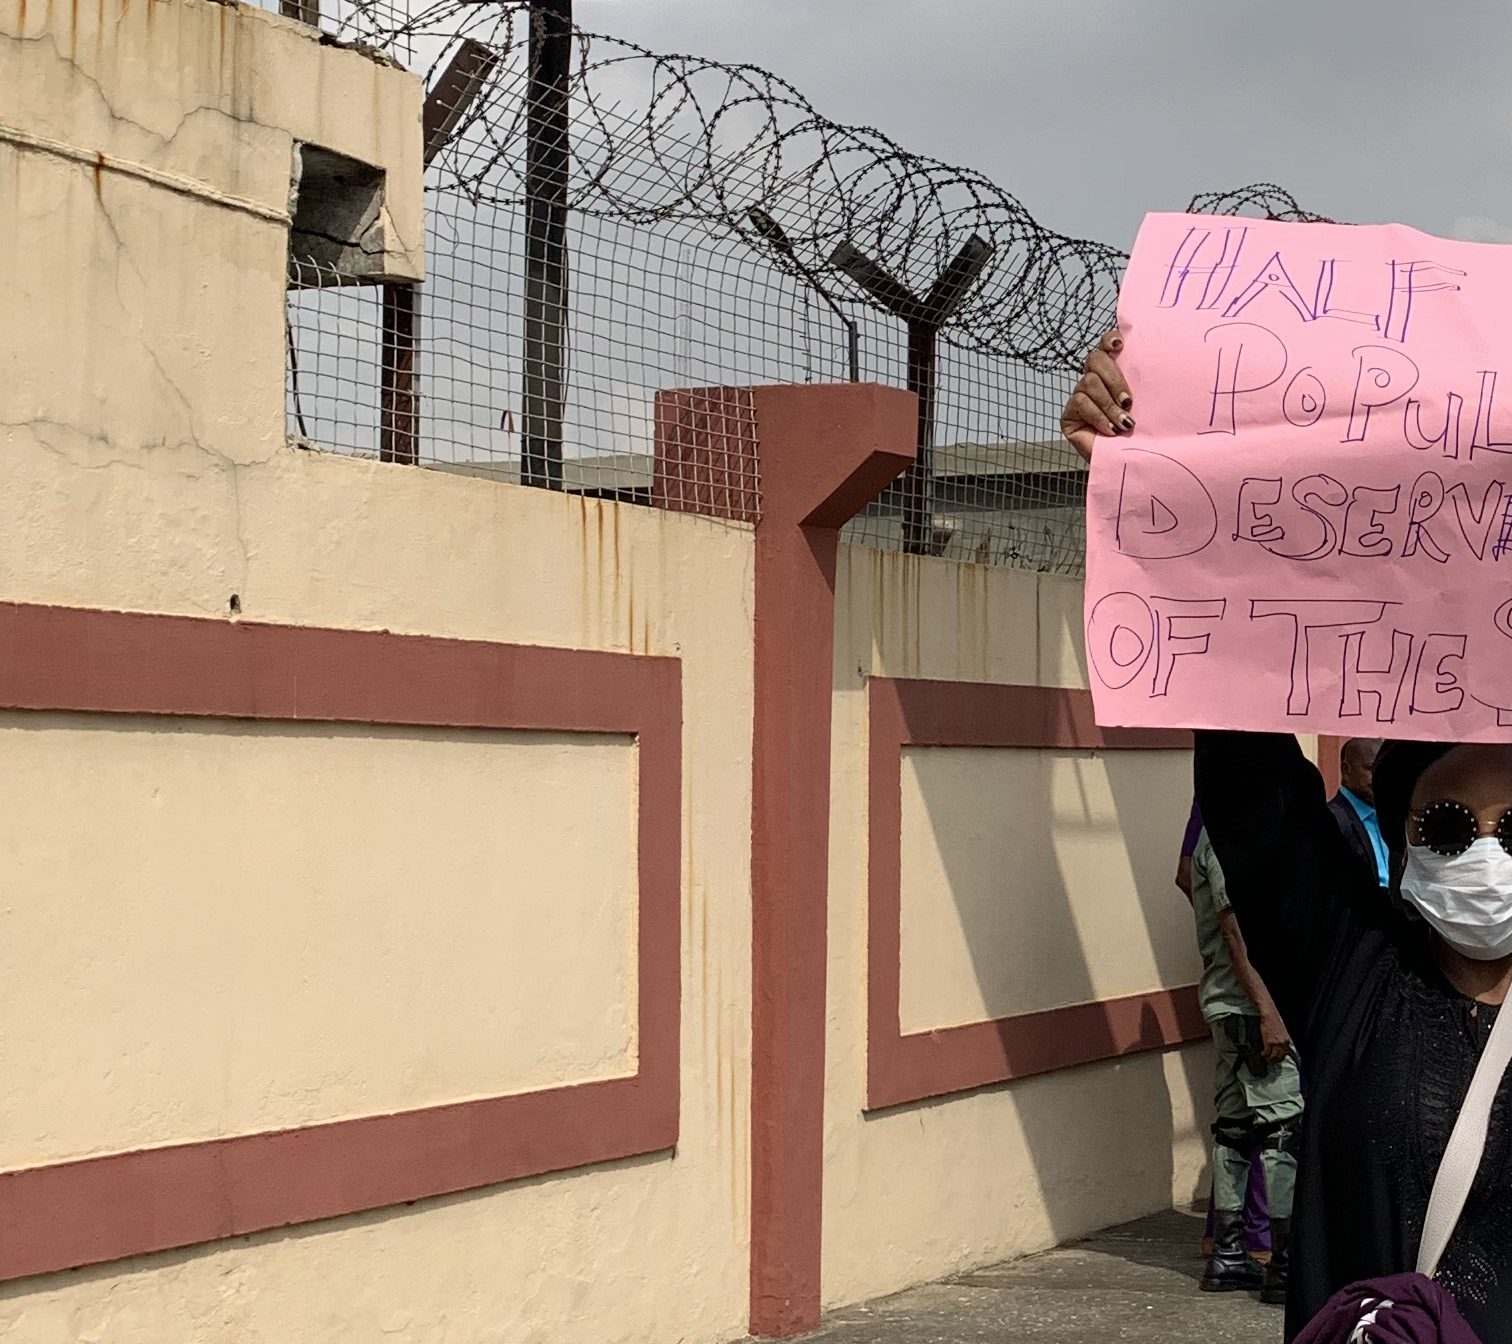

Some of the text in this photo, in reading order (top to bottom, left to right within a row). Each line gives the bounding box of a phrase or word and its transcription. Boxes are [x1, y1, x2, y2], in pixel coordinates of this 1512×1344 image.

[1159, 226, 1467, 341] HALF
[1088, 591, 1226, 698] OF
[1250, 599, 1468, 724] THE
